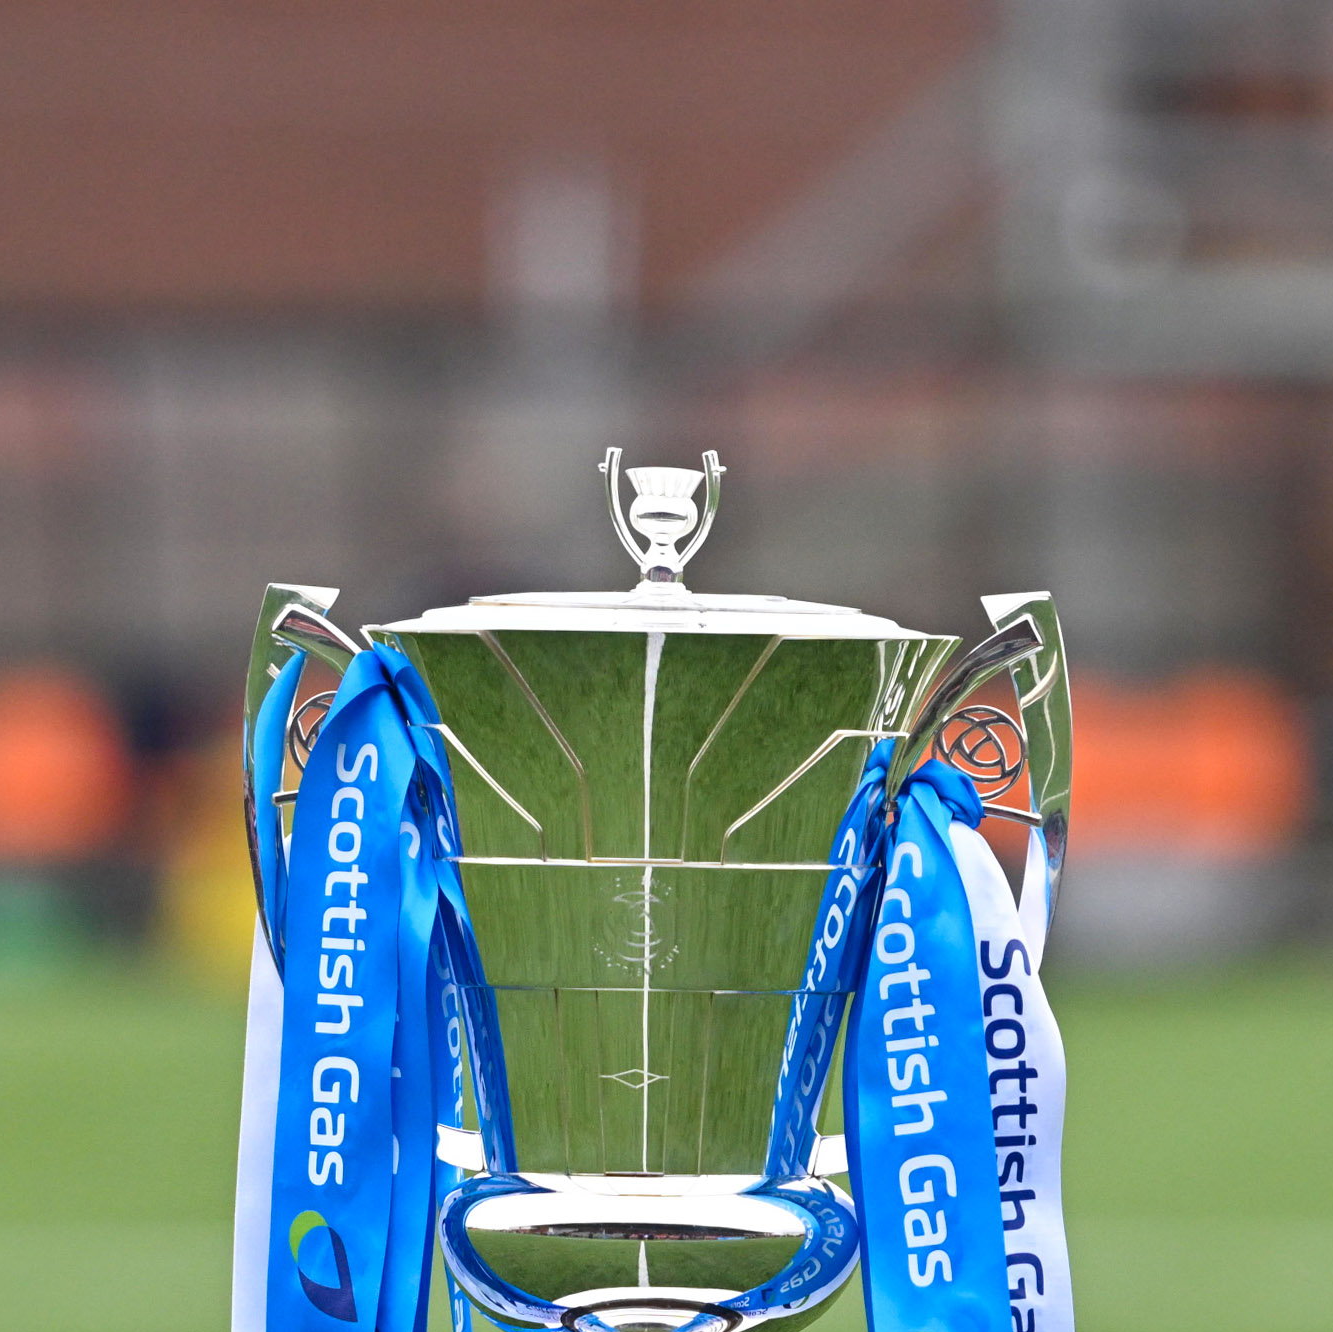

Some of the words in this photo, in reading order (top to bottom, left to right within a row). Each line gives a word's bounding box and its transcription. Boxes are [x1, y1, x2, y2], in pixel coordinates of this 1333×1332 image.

[314, 742, 379, 1035] Scottish
[874, 839, 948, 1137] Scottish
[307, 1055, 361, 1187] Gas
[898, 1153, 958, 1288] Gas
[979, 937, 1038, 1231] Scottish
